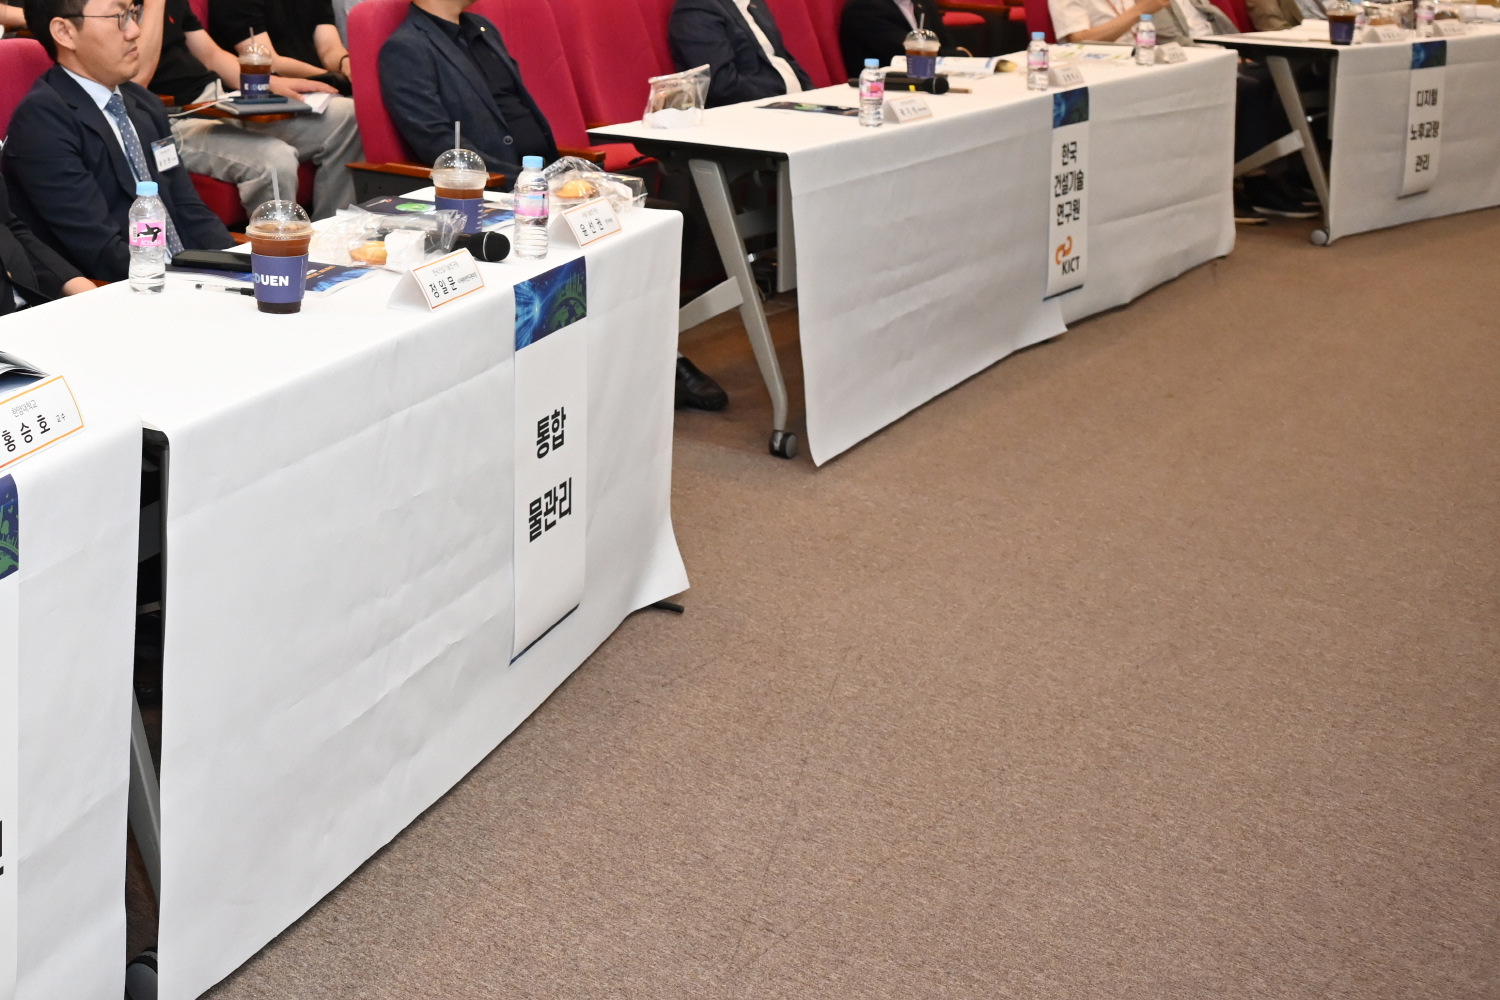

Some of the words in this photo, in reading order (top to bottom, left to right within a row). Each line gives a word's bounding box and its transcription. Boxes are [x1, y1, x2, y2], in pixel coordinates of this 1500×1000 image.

[1410, 120, 1440, 140] 노후교량
[1061, 141, 1077, 166] 한국
[1415, 153, 1430, 172] 관리
[1054, 169, 1084, 198] 건설기술
[1056, 198, 1081, 226] 연구원
[1061, 256, 1080, 276] KICT
[11, 399, 38, 418] 한양대학교
[536, 406, 566, 459] 통합
[528, 477, 572, 543] 물관리
